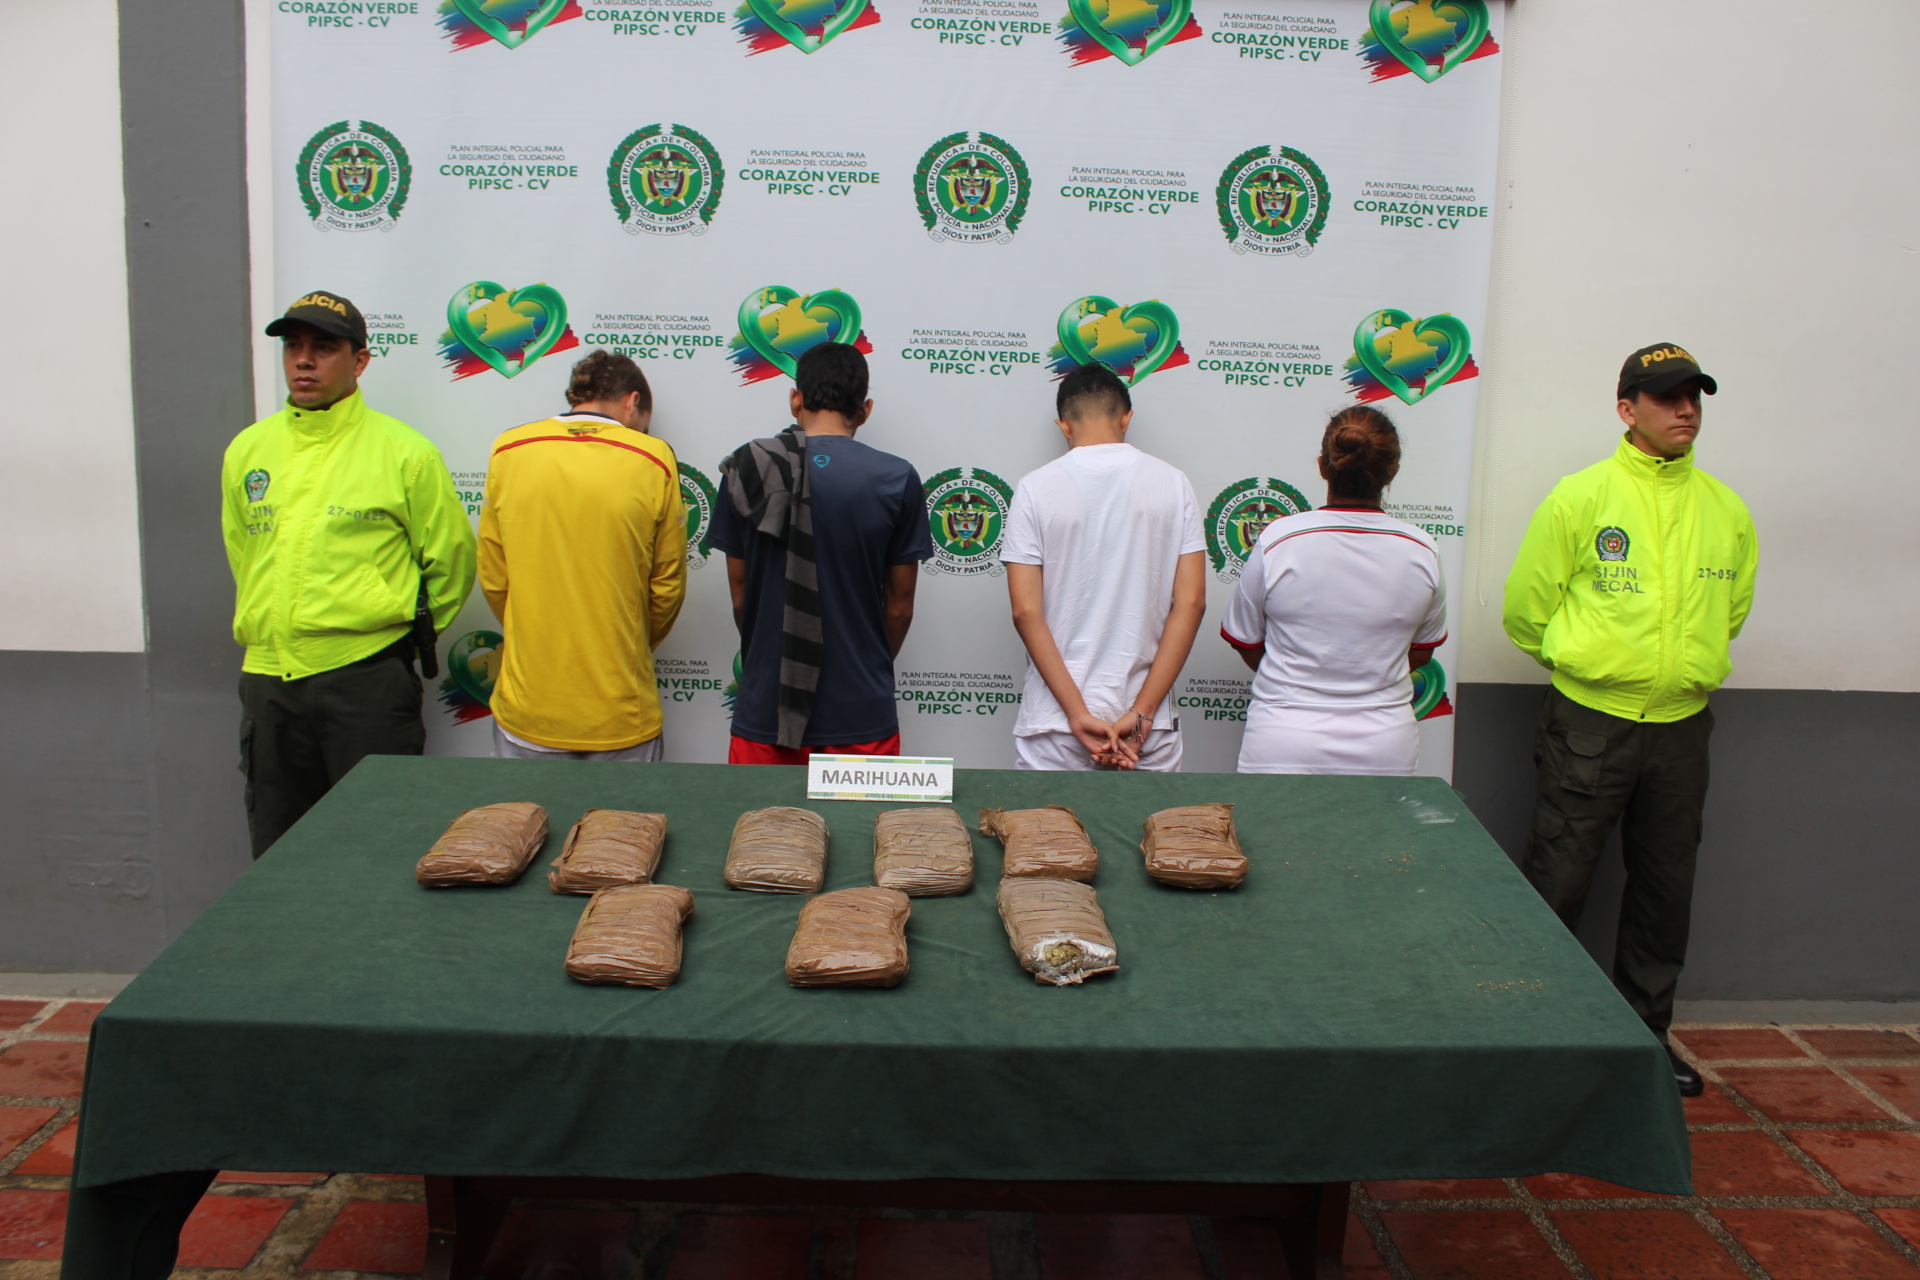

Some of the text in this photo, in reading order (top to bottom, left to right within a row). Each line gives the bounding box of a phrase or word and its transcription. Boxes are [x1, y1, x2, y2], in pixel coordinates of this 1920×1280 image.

[365, 2, 418, 14] VERDE
[308, 15, 354, 27] PIPSC
[368, 16, 390, 27] CV
[583, 8, 726, 23] CORAZÓN VERDE
[1245, 14, 1280, 22] INTEGRAL
[1283, 16, 1315, 24] POLICIAL
[614, 23, 660, 35] PIPSC
[674, 24, 697, 36] CV
[910, 17, 1052, 34] CORAZÓN VERDE
[1231, 22, 1273, 30] SEGURIDAD
[1290, 25, 1336, 34] CIUDADANO
[940, 32, 986, 45] PIPSC
[1000, 34, 1023, 46] CV
[1212, 31, 1350, 50] CORAZÓN VERDE
[1240, 46, 1285, 60] PIPSC
[1299, 50, 1322, 62] CV
[439, 163, 578, 177] CORAZÓN VERDE
[739, 168, 880, 184] CORAZÓN VERDE
[990, 150, 1016, 195] COLOMBIA
[1132, 169, 1164, 177] POLICIAL
[468, 178, 513, 190] PIPSC
[527, 178, 550, 190] CV
[1080, 176, 1122, 184] SEGURIDAD
[1140, 178, 1186, 186] CIUDADANO
[1292, 164, 1316, 208] COLOMBIA
[768, 183, 814, 195] PIPSC
[828, 184, 851, 196] CV
[1060, 185, 1199, 203] CORAZÓN VERDE
[1373, 190, 1413, 198] SEGURIDAD
[1430, 194, 1475, 202] CIUDADANO
[1089, 200, 1134, 213] PIPSC
[1148, 202, 1171, 215] CV
[1354, 200, 1488, 217] CORAZÓN VERDE
[972, 204, 1013, 230] NACIONAL
[1381, 214, 1424, 228] PIPSC
[1437, 218, 1460, 230] CV
[971, 228, 1001, 240] PATRIA
[1272, 218, 1312, 243] NACIONAL
[1272, 242, 1301, 253] PATRIA
[585, 332, 724, 346] CORAZÓN VERDE
[673, 348, 696, 359] CV
[901, 348, 1040, 363] CORAZÓN VERDE
[930, 362, 975, 375] PIPSC
[990, 364, 1012, 375] CV
[1198, 359, 1334, 376] CORAZÓN VERDE
[1225, 373, 1270, 386] PIPSC
[1284, 376, 1306, 387] CV
[1595, 566, 1637, 579] SIJIN
[1592, 580, 1645, 594] MECAL
[671, 679, 722, 690] VERDE
[968, 681, 1014, 689] CIUDADANO
[673, 691, 695, 702] CV
[892, 690, 1023, 704] CORAZÓN VERDE
[918, 703, 962, 714] PIPSC
[976, 706, 998, 716] CV
[822, 769, 938, 787] MARIHUANA
